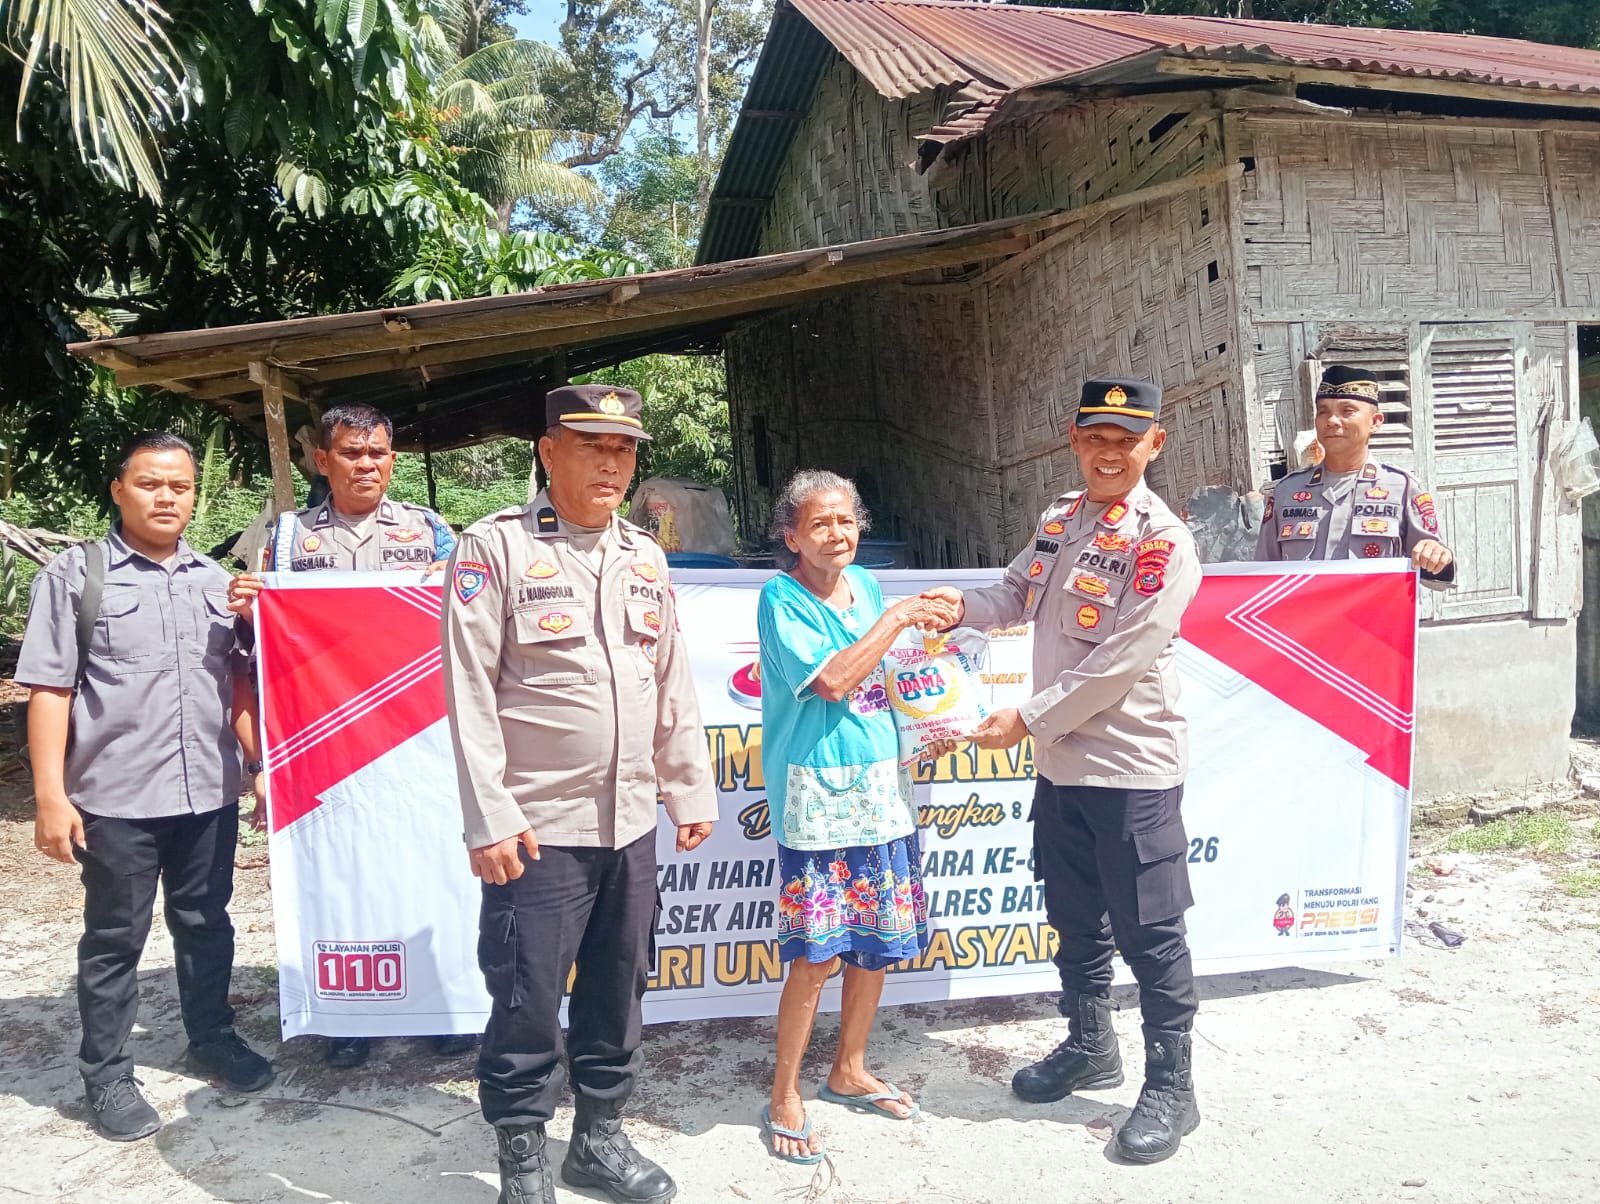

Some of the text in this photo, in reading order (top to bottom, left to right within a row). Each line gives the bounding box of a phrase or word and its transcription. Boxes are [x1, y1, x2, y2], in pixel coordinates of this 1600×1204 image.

[1355, 505, 1398, 517] POLRI
[382, 548, 427, 562] POLRI
[1079, 552, 1127, 575] POLRI
[707, 859, 775, 890] HARI
[1188, 836, 1220, 864] 26
[1304, 887, 1362, 898] TRANSFORMASI
[1304, 897, 1379, 910] MENUJU POLRI YANG
[726, 901, 775, 931] AIR
[329, 944, 400, 952] LAYANAN POLISI
[324, 958, 397, 987] 110
